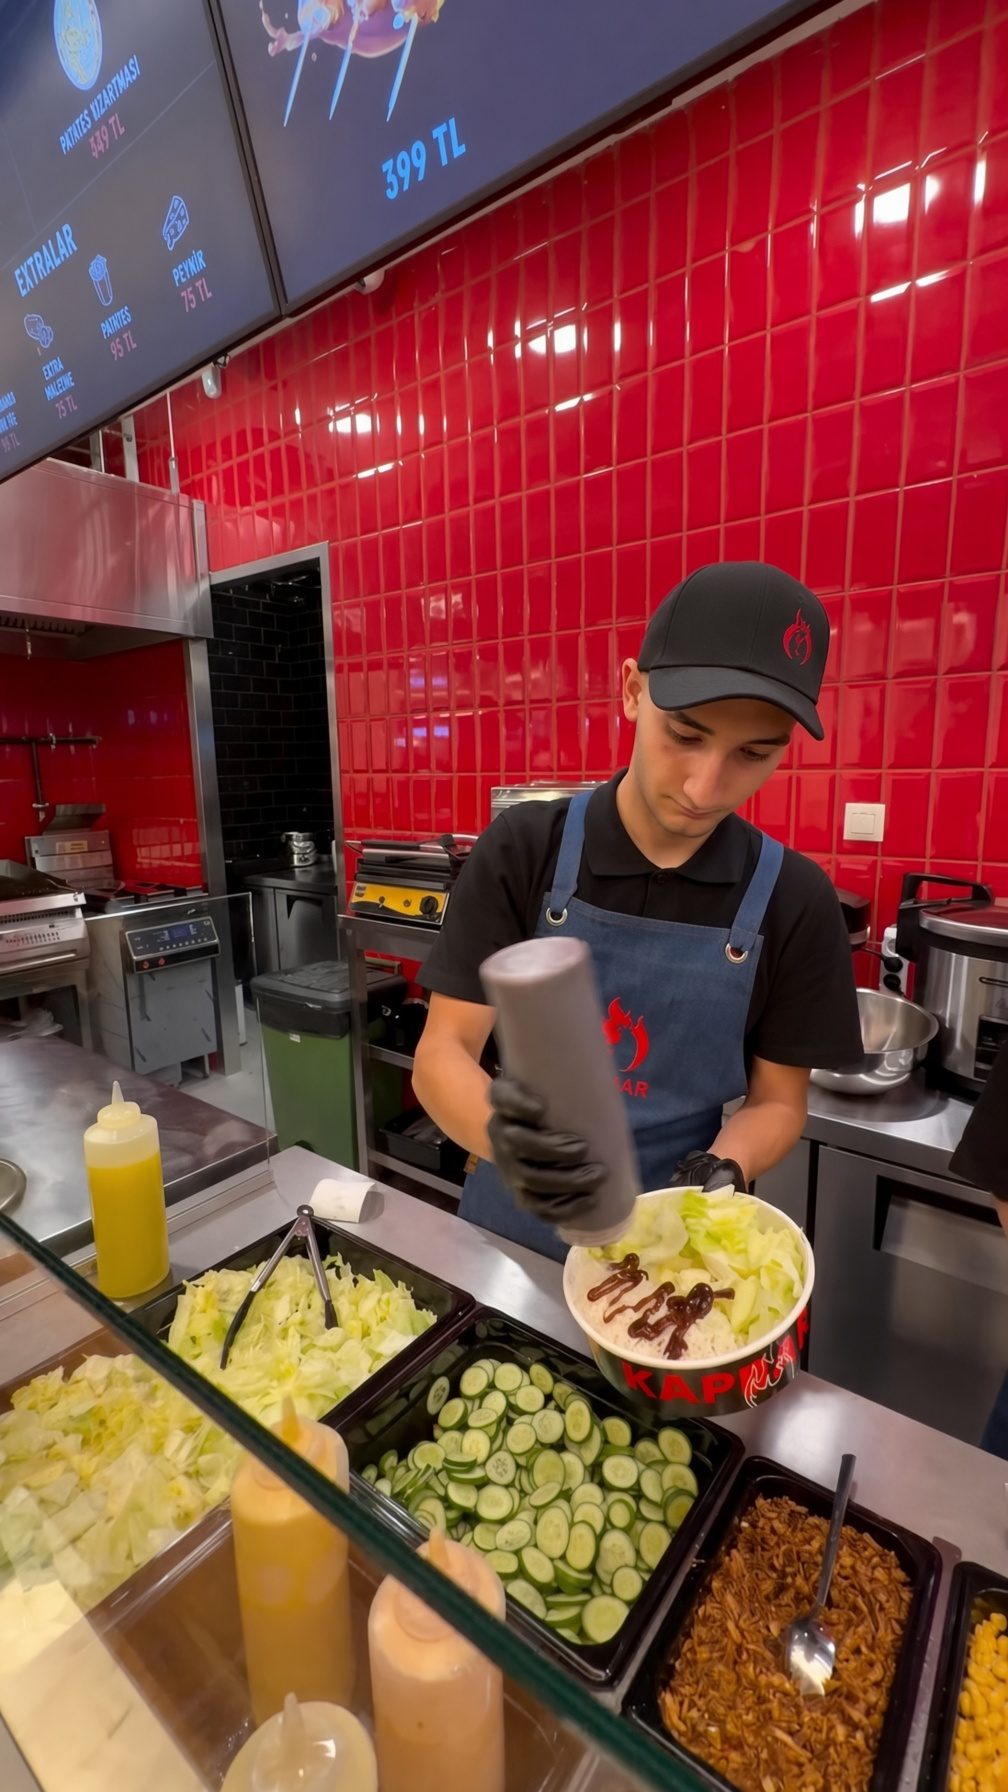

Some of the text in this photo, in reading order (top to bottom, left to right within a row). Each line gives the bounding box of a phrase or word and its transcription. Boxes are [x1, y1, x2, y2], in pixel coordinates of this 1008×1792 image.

[60, 108, 92, 155] PATATES
[108, 112, 126, 140] TL
[381, 117, 466, 200] 399 TL
[14, 223, 78, 297] EXTRALAR
[172, 249, 207, 287] PEYNİR
[180, 277, 213, 313] 75 TL
[110, 330, 137, 361] 95 TL
[64, 394, 78, 413] TL
